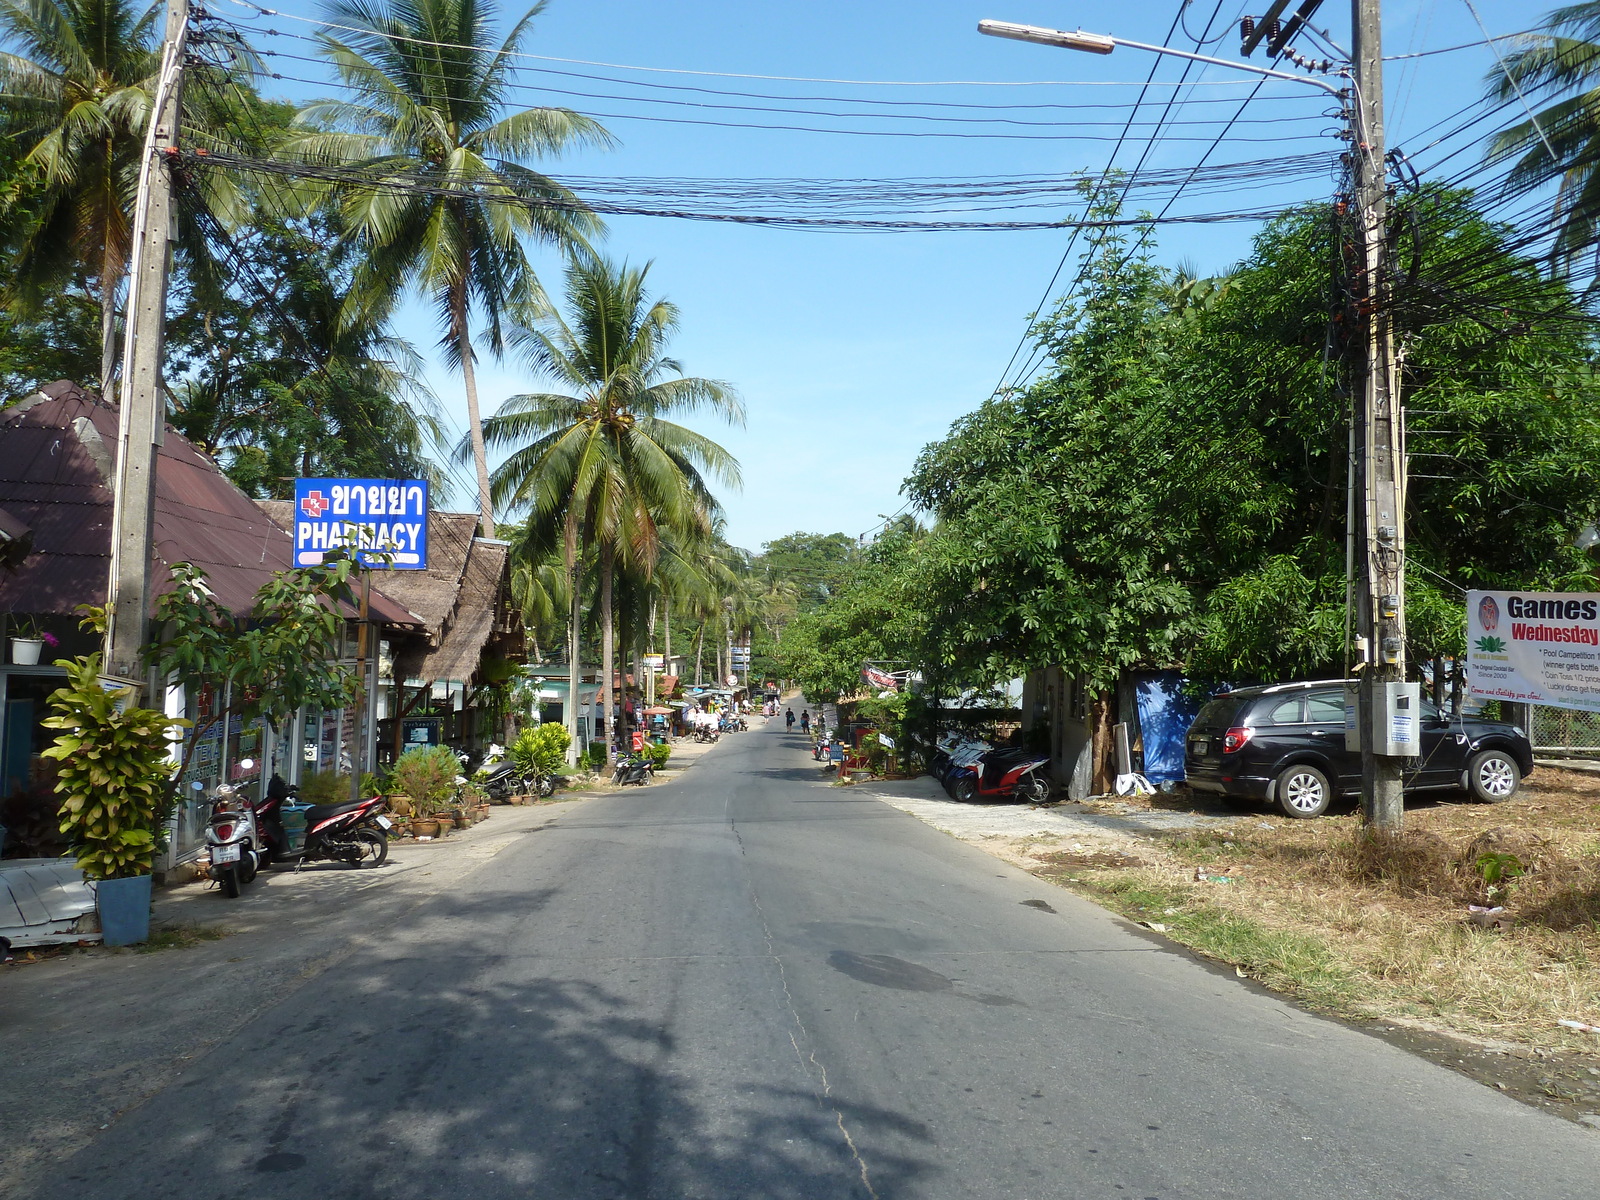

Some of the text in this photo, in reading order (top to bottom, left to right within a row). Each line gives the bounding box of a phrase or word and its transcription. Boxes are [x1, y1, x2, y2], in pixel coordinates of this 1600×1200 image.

[331, 485, 423, 515] ขายยา
[298, 521, 421, 551] PHARMACY
[1507, 596, 1597, 620] Games
[1511, 622, 1598, 646] Wednesday
[1543, 649, 1557, 657] Pool
[1543, 661, 1599, 671] (winner gets bottle
[1545, 671, 1558, 679] Coin
[1547, 682, 1564, 692] Lucky
